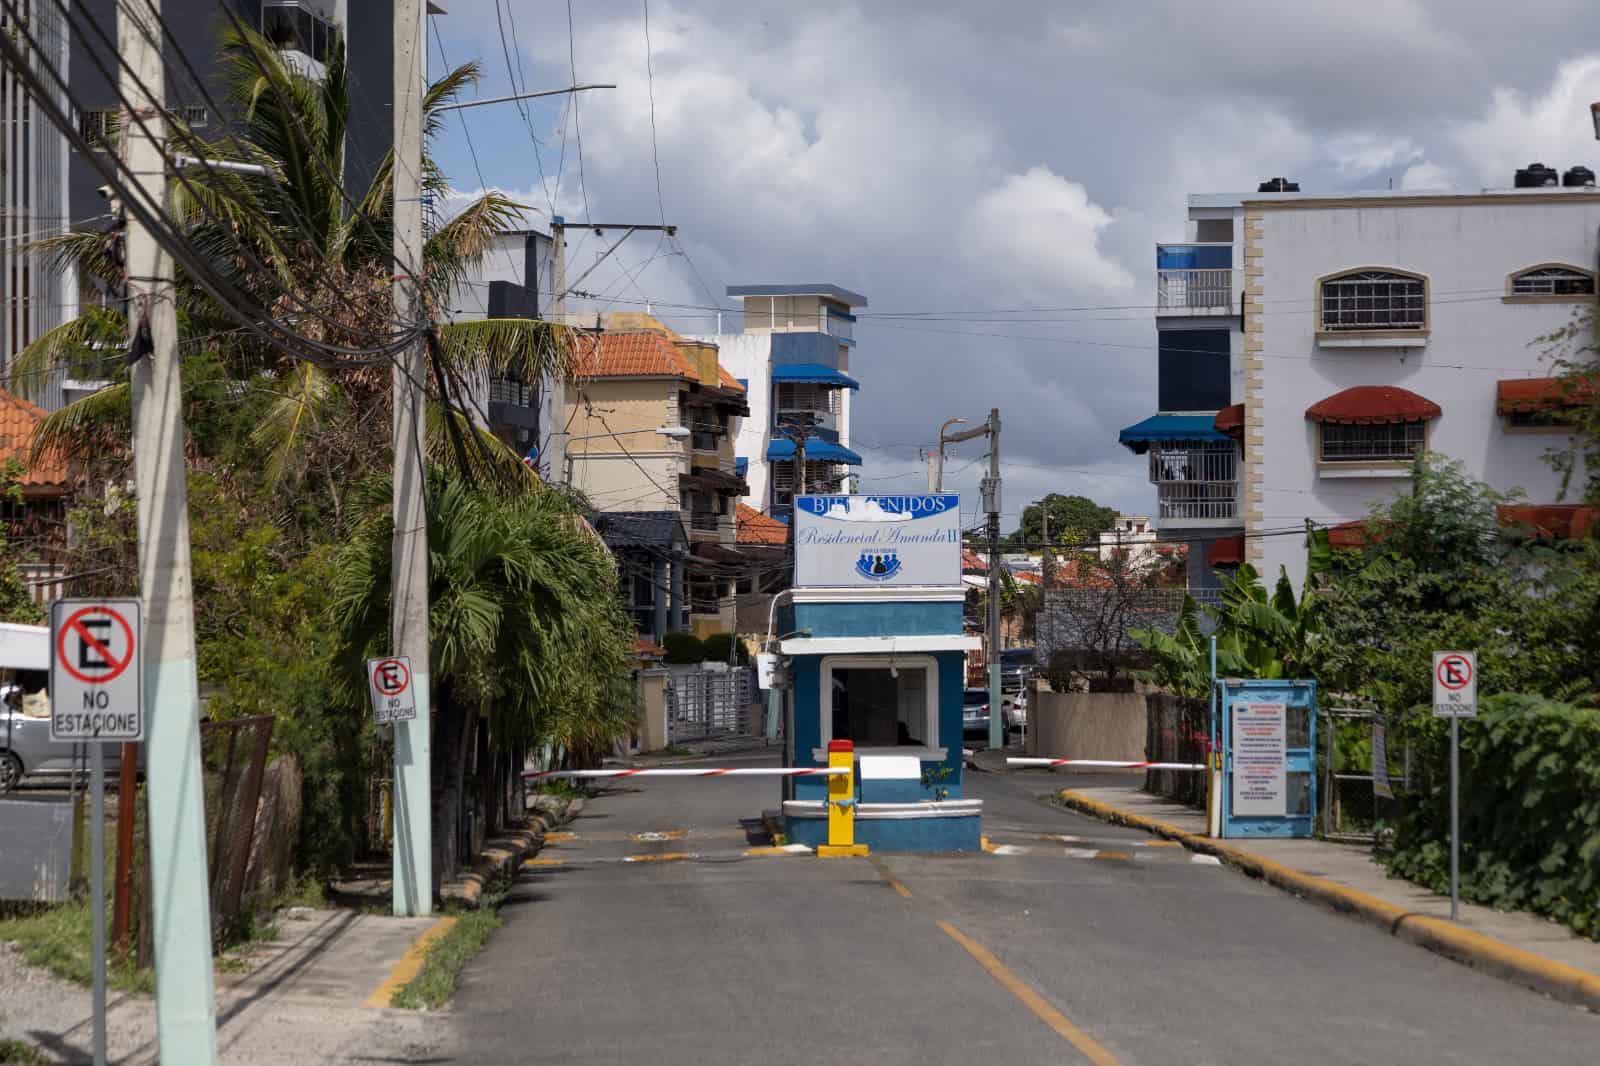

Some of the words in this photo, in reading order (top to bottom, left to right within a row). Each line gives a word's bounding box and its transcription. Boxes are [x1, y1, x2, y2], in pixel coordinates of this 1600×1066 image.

[798, 527, 880, 545] Residencial
[83, 690, 109, 709] NO
[388, 698, 401, 708] NO
[1448, 693, 1461, 702] NO
[56, 713, 136, 732] ESTACIONE
